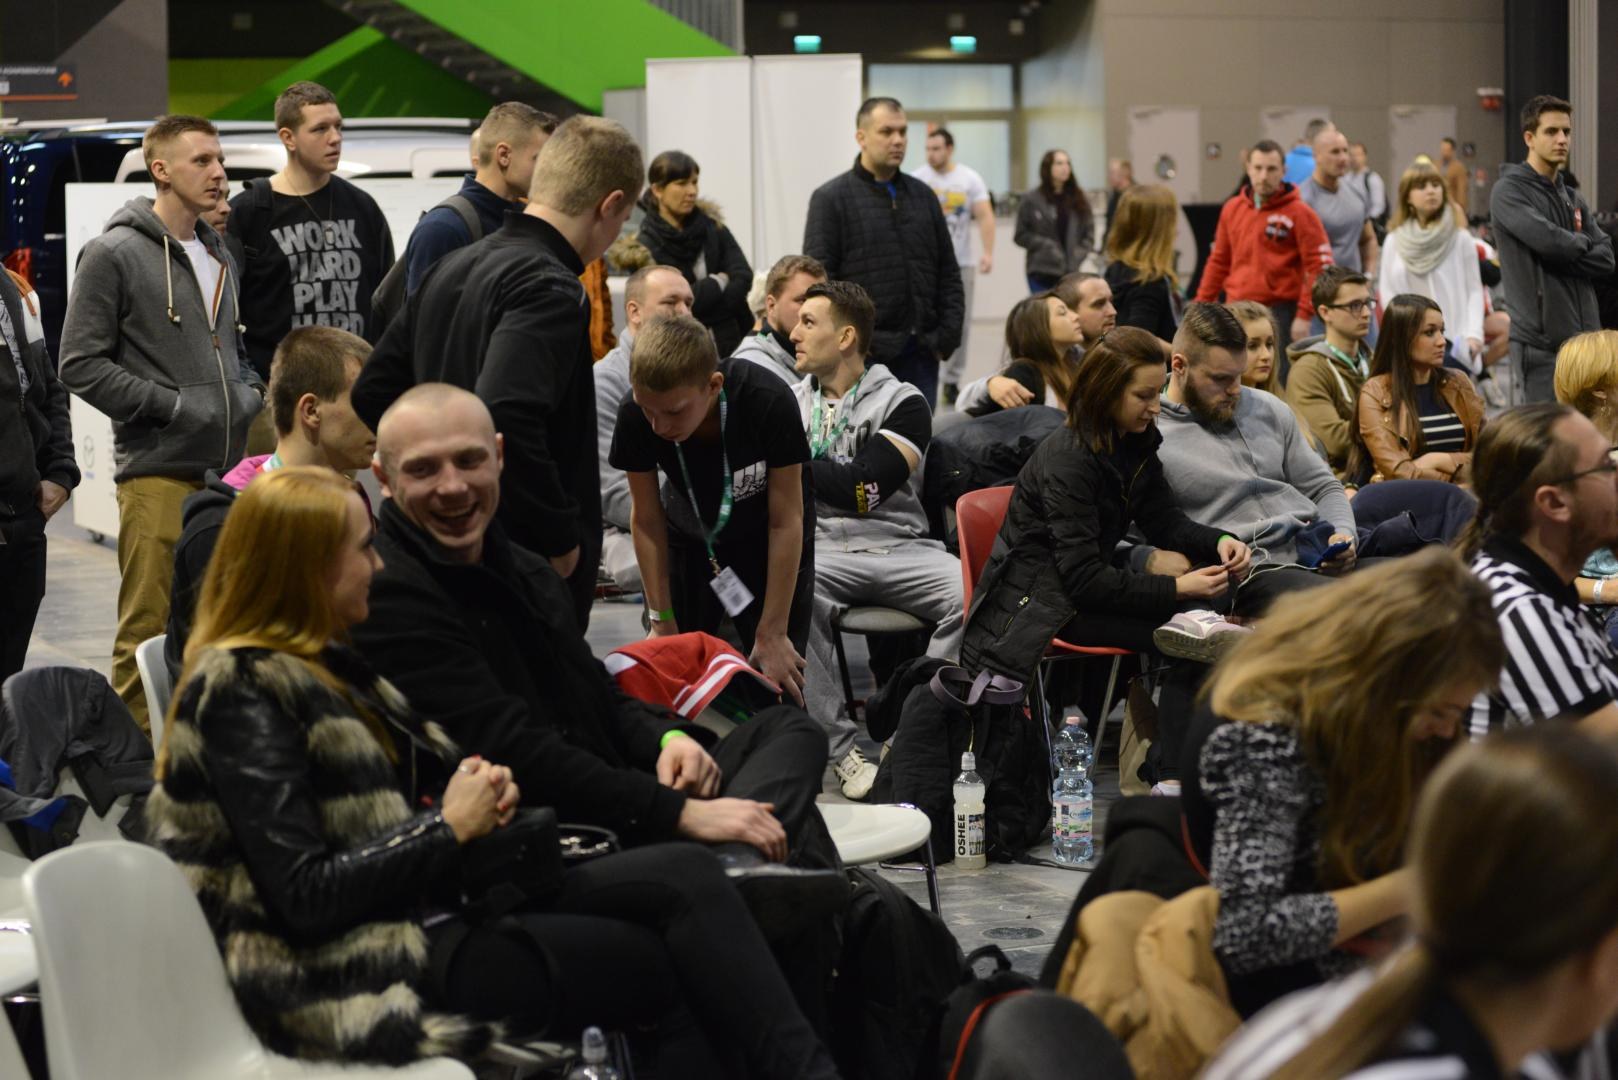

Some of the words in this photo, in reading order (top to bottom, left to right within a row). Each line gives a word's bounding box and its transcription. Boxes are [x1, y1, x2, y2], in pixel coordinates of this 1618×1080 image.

[270, 219, 362, 255] WORK
[288, 249, 361, 284] HARD
[293, 281, 358, 313] PLAY
[957, 814, 966, 856] OSHEE
